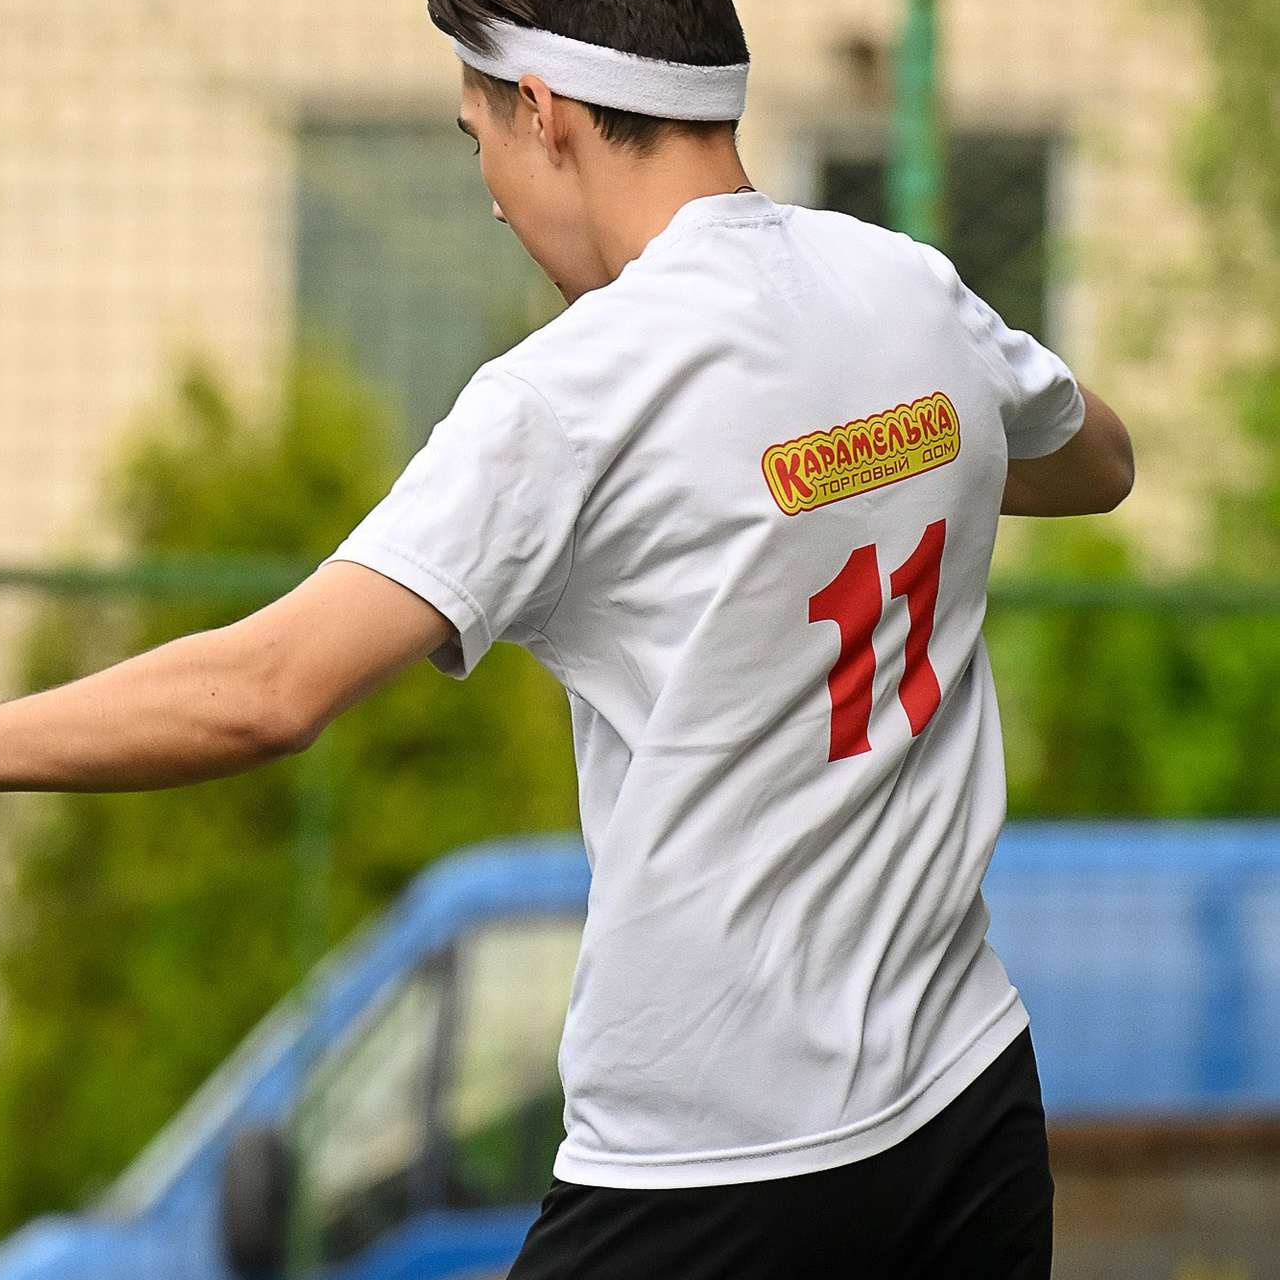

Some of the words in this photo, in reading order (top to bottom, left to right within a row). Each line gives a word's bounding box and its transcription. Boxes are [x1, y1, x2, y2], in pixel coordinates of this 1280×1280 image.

[819, 456, 910, 496] ТОРГОВЫЙ
[922, 440, 955, 464] ДОМ
[808, 517, 947, 763] 11
